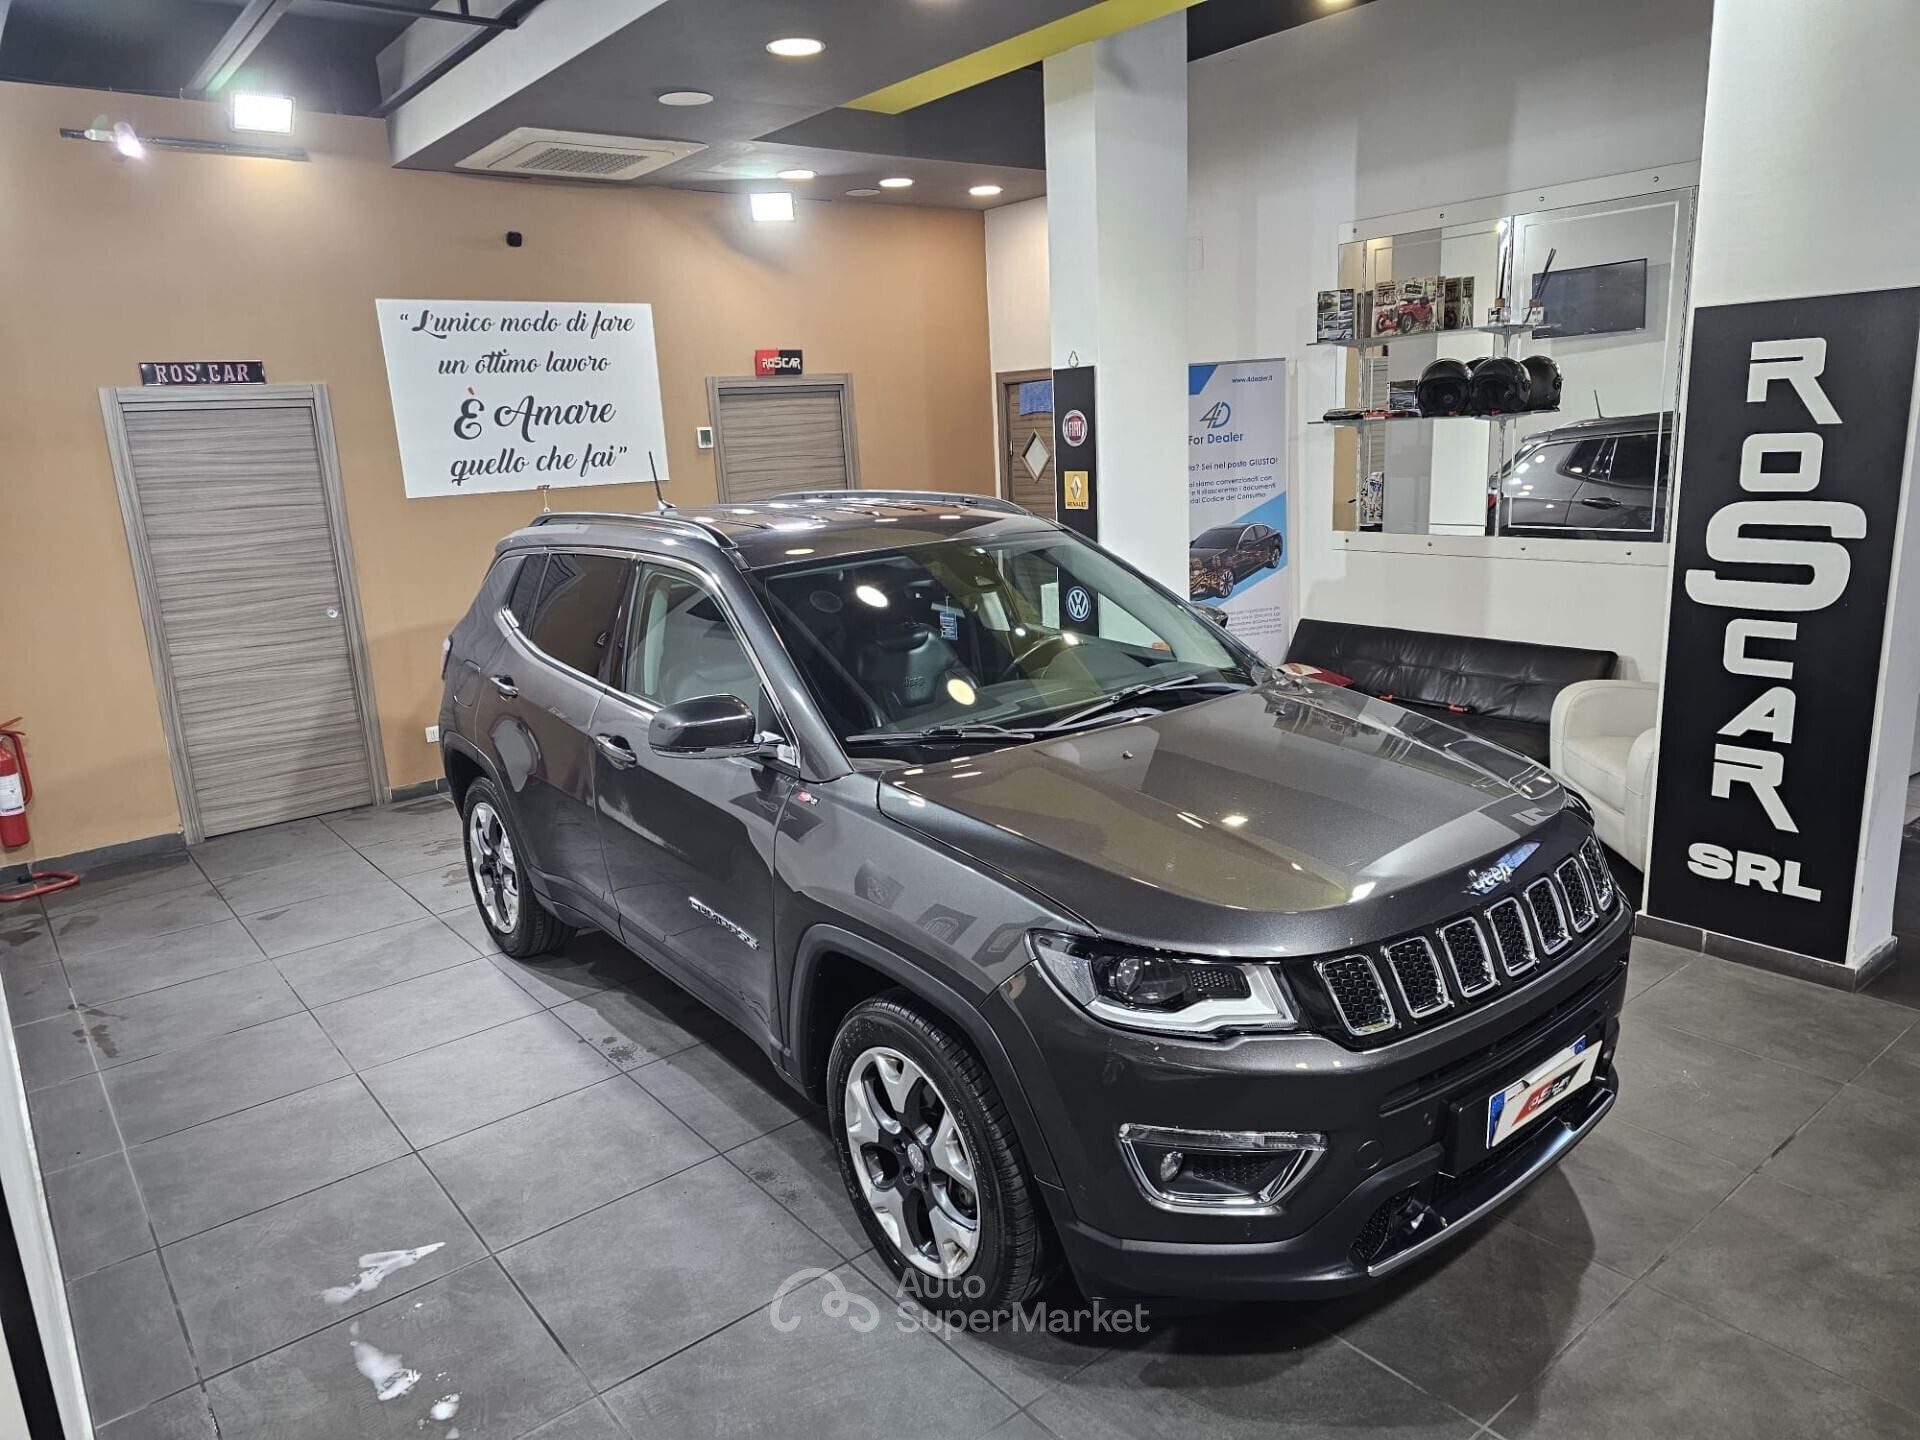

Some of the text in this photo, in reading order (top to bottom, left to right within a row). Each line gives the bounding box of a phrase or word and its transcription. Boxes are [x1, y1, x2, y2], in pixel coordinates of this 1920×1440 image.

[500, 310, 561, 332] modo
[566, 310, 588, 332] di
[590, 310, 635, 340] fare
[438, 349, 611, 375] un ottimo lavoro
[453, 387, 616, 443] È Amare
[1068, 421, 1082, 437] FIAT
[1207, 432, 1244, 444] Dealer
[450, 448, 529, 486] quello
[536, 445, 577, 472] che
[1201, 463, 1212, 471] Sei
[1214, 461, 1226, 470] nel
[1227, 460, 1247, 469] posto
[1201, 495, 1225, 503] Codice
[1237, 492, 1266, 500] Consumo
[1687, 842, 1822, 902] SRL
